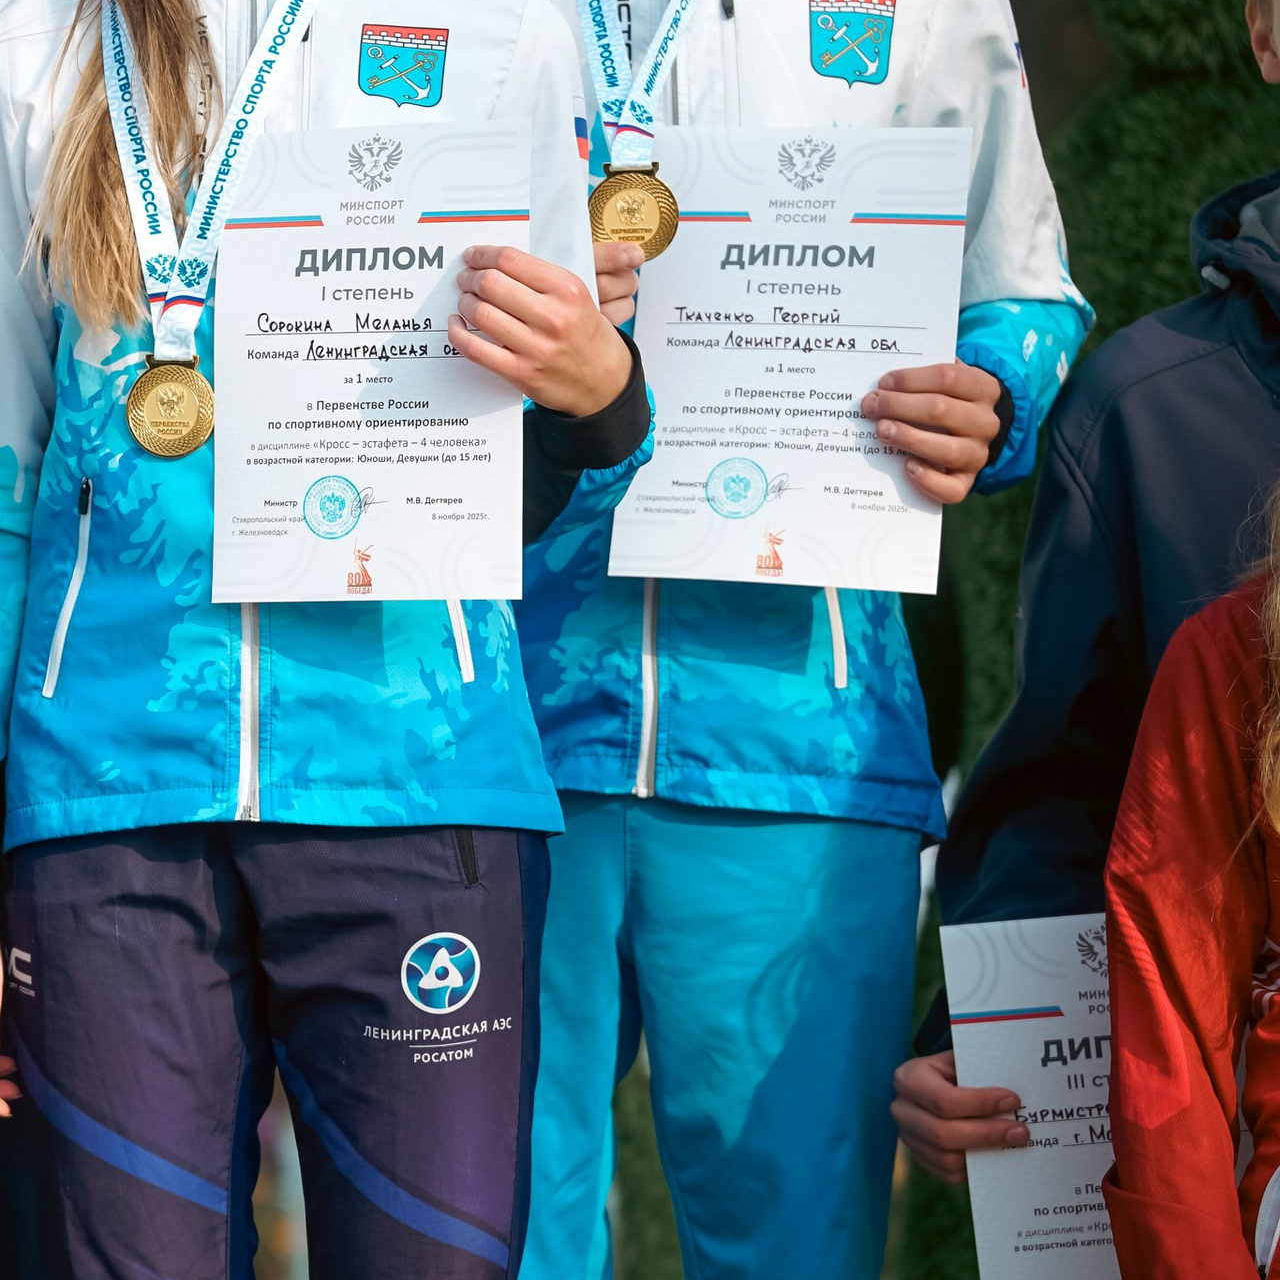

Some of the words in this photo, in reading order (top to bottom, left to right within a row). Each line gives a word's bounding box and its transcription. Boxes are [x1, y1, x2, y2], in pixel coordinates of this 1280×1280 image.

[643, 9, 682, 97] МИНИСТЕРСТВО
[598, 42, 619, 88] РОССИИ
[196, 118, 248, 240] МИНИСТЕРСТВО
[242, 59, 276, 115] СПОРТА
[124, 105, 147, 165] СПОРТА
[137, 168, 162, 236] РОССИИ
[339, 199, 405, 212] МИНСПОРТ
[768, 199, 837, 210] МИНСПОРТ
[345, 214, 396, 226] РОССИИ
[774, 213, 827, 224] РОССИИ
[294, 245, 445, 278] ДИПЛОМ
[719, 243, 876, 271] ДИПЛОМ
[331, 286, 415, 302] степень
[756, 282, 842, 296] степень
[666, 336, 721, 349] Команда
[246, 348, 300, 362] Команда
[777, 362, 784, 374] 1
[786, 366, 817, 375] место
[343, 376, 354, 385] за
[356, 372, 363, 385] 1
[365, 375, 394, 385] место
[733, 386, 806, 400] Первенстве
[808, 388, 853, 402] России
[306, 402, 314, 412] в
[315, 399, 385, 414] Первенстве
[387, 398, 430, 410] России
[681, 405, 698, 415] по
[699, 405, 782, 419] спортивному
[784, 407, 873, 423] ориентирова
[267, 421, 283, 431] по
[284, 419, 363, 432] спортивному
[364, 417, 470, 431] ориентированию
[363, 1020, 488, 1041] ЛЕНИНГРАДСКАЯ
[492, 1017, 513, 1030] АЭС
[413, 1047, 474, 1064] РОСАТОМ
[1041, 1035, 1111, 1067] ДИП
[1053, 1202, 1105, 1216] спортив
